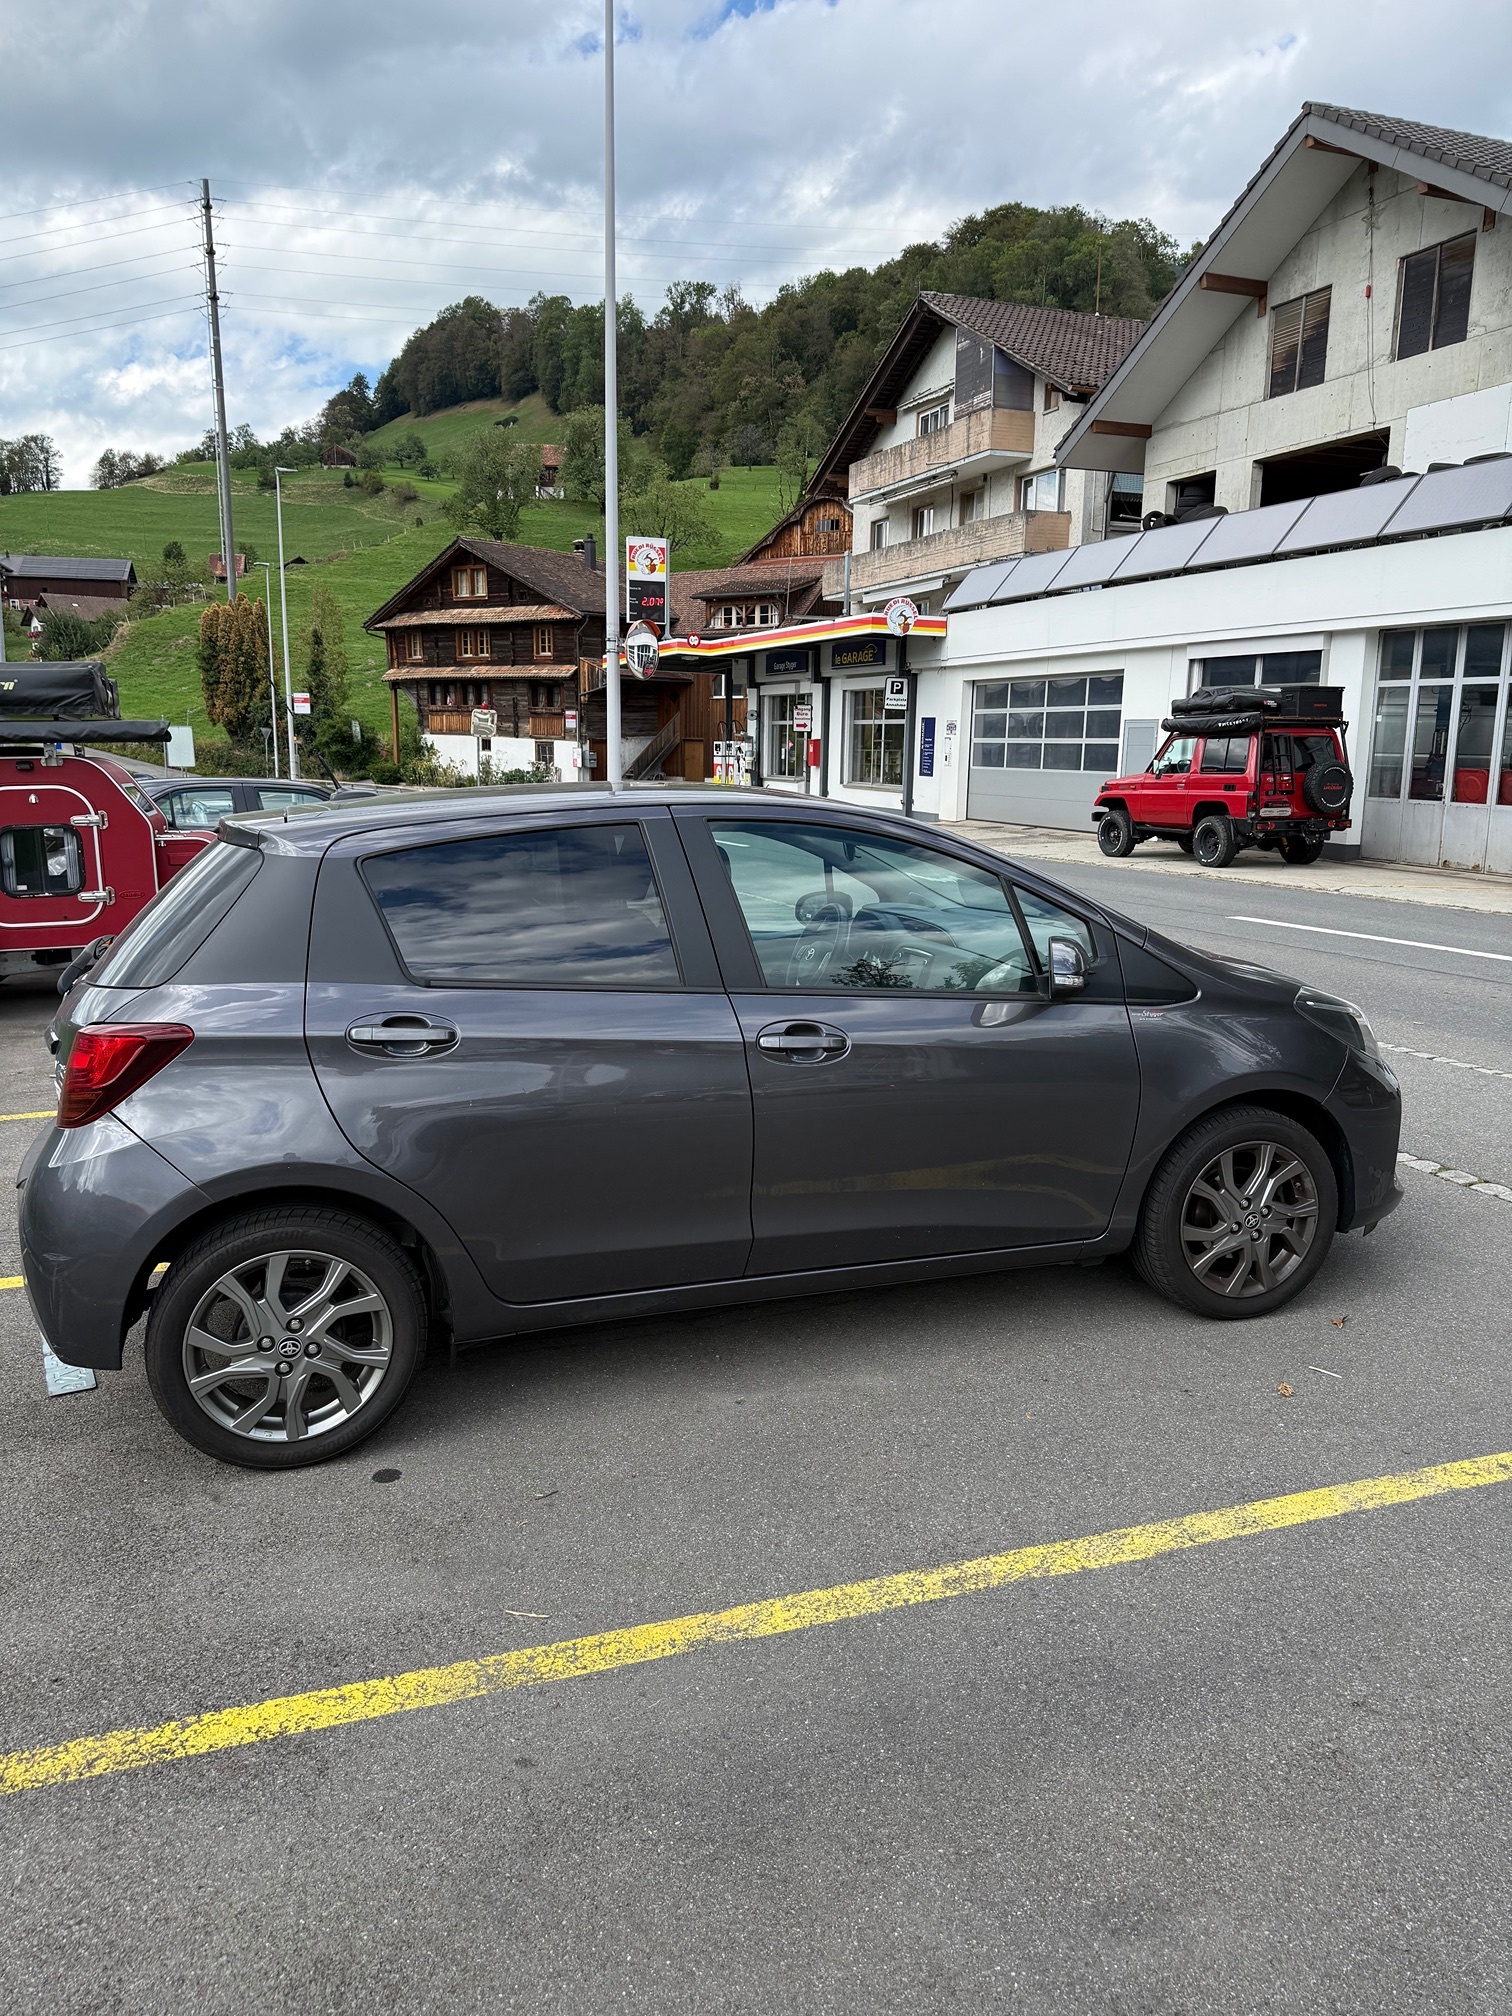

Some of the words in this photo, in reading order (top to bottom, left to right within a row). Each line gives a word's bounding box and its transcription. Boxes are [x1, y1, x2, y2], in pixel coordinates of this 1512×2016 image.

[631, 543, 645, 560] RUEDI
[884, 599, 900, 617] RUEDI
[900, 597, 919, 620] RÜSSEL
[834, 653, 841, 665] le
[841, 649, 874, 664] GARAGE
[773, 662, 786, 672] Garage
[786, 660, 798, 671] Styger
[893, 682, 902, 693] P
